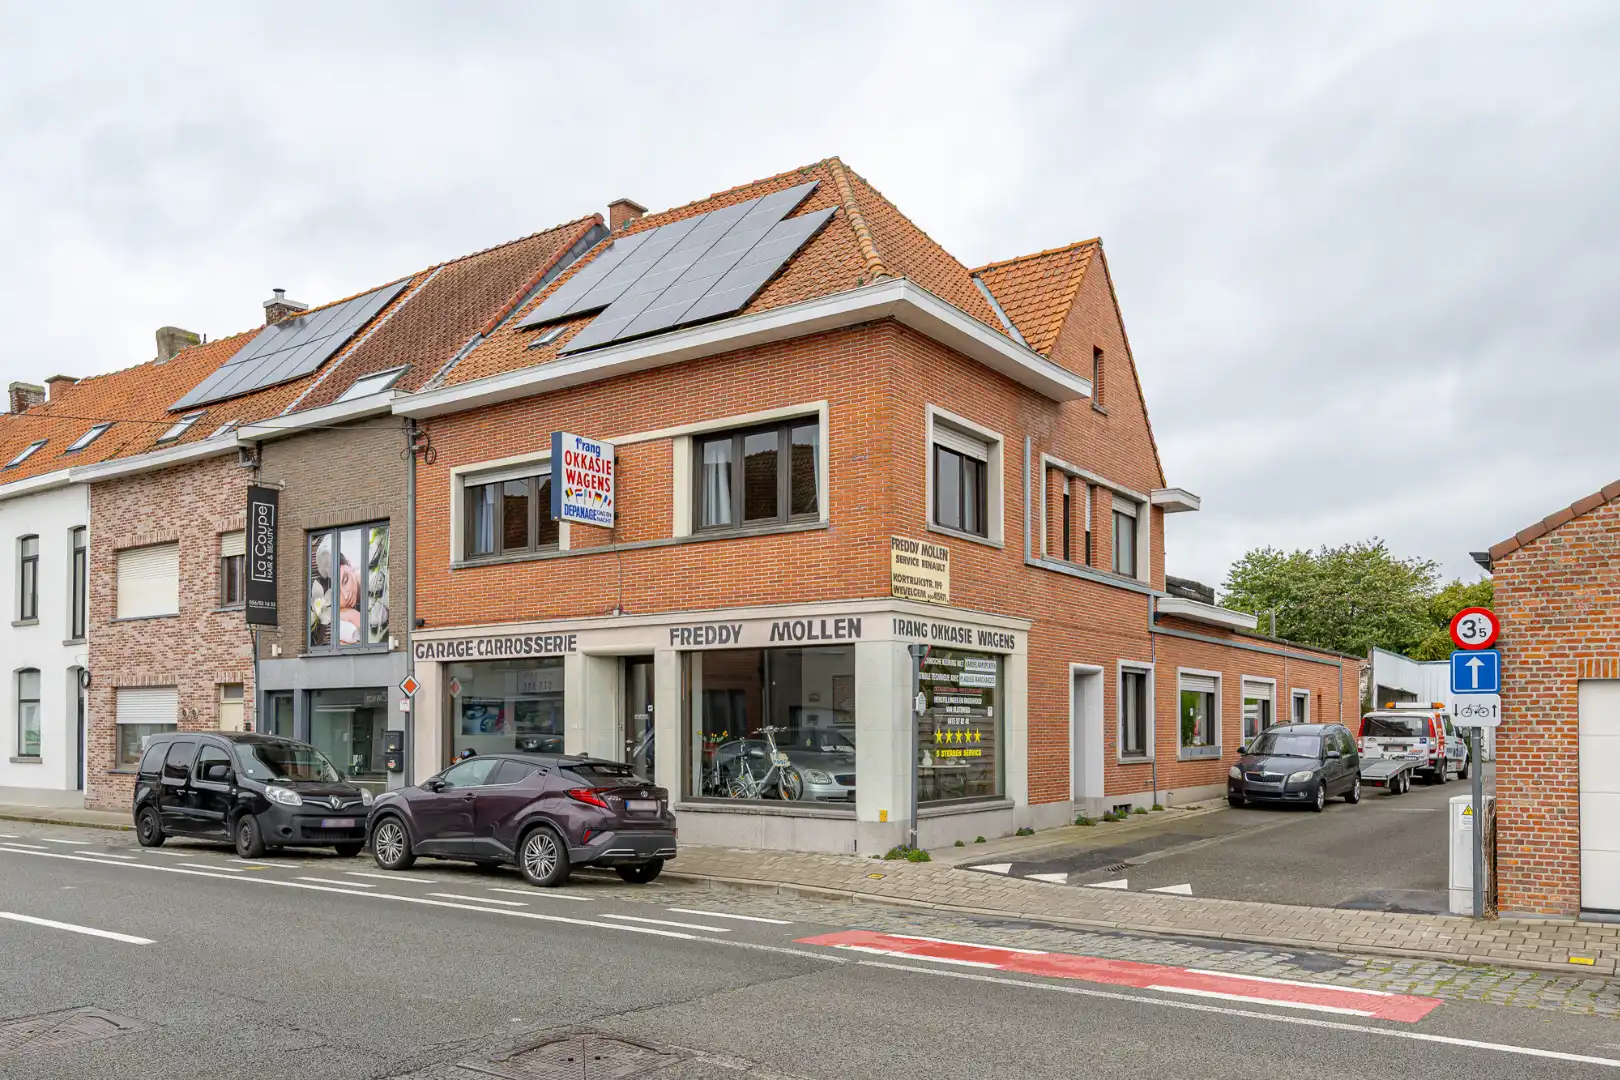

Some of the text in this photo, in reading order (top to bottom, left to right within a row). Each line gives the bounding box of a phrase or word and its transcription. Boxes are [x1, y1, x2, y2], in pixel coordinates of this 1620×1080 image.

[564, 450, 612, 475] OKKASIE
[565, 468, 611, 493] WAGENS
[564, 503, 597, 521] DEPANAGE
[255, 505, 269, 577] La Coupe
[891, 536, 949, 562] FREDDY MOLLEN
[895, 554, 946, 573] SERVICE RENAULT
[893, 584, 927, 599] WEVELGEM
[669, 617, 862, 647] FREDDY MOLLEN
[931, 623, 972, 645] OKKASIE
[977, 629, 1015, 650] WAGENS
[963, 748, 982, 757] SERVICE
